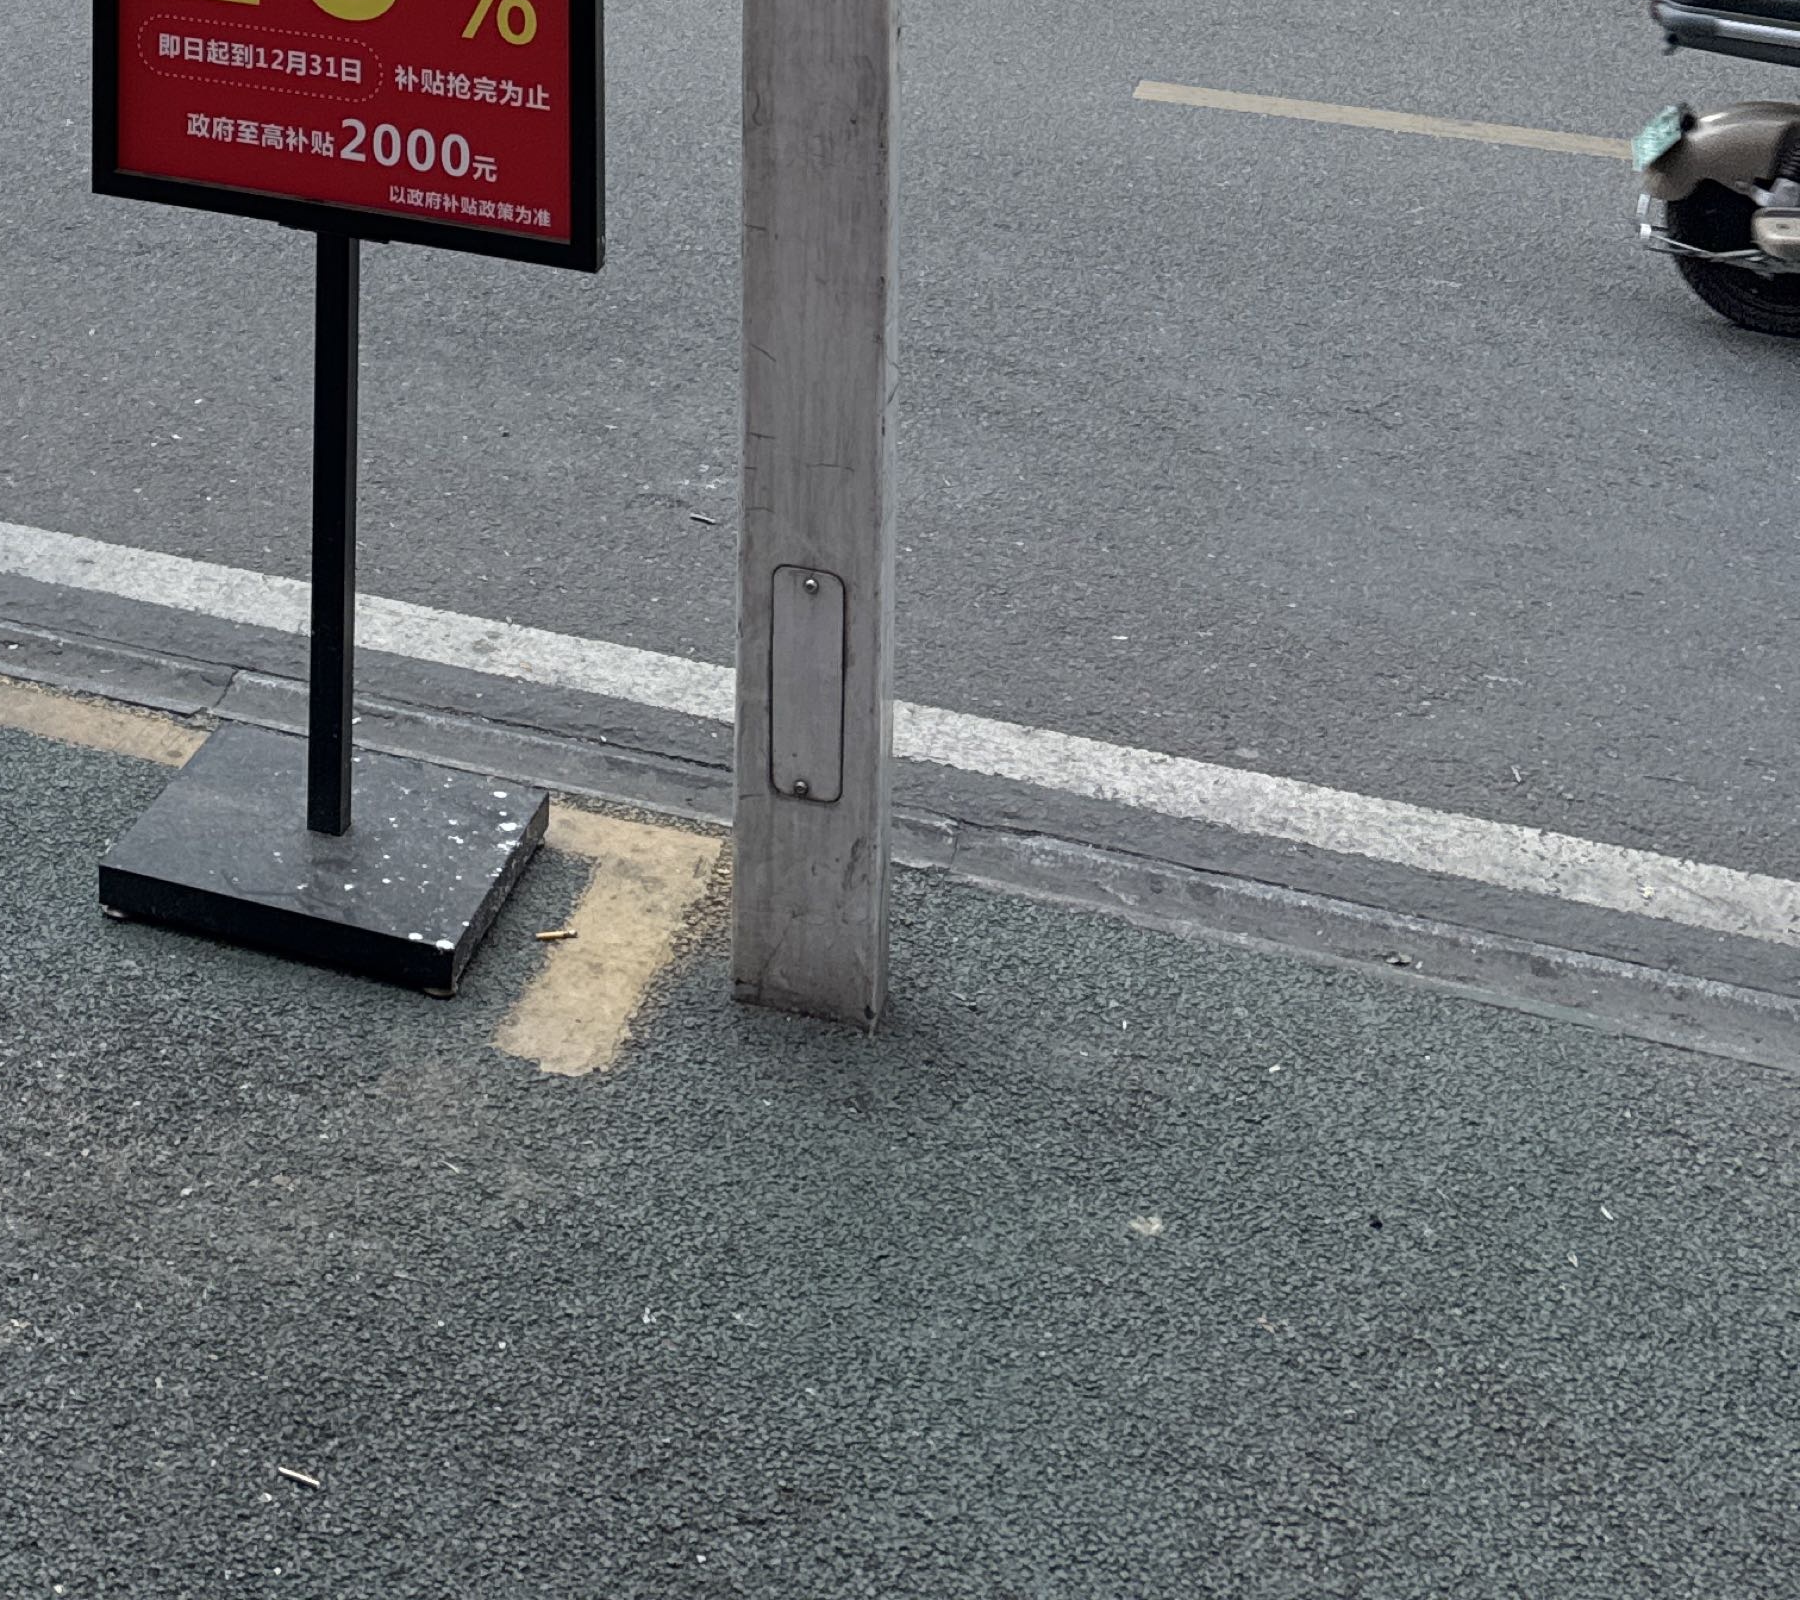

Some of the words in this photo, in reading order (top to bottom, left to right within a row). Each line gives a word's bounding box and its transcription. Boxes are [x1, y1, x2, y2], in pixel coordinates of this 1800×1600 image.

[158, 31, 363, 85] 即日起到12月31日
[394, 65, 552, 113] 补贴抢完为止
[388, 184, 553, 230] 以政府补贴政策为准
